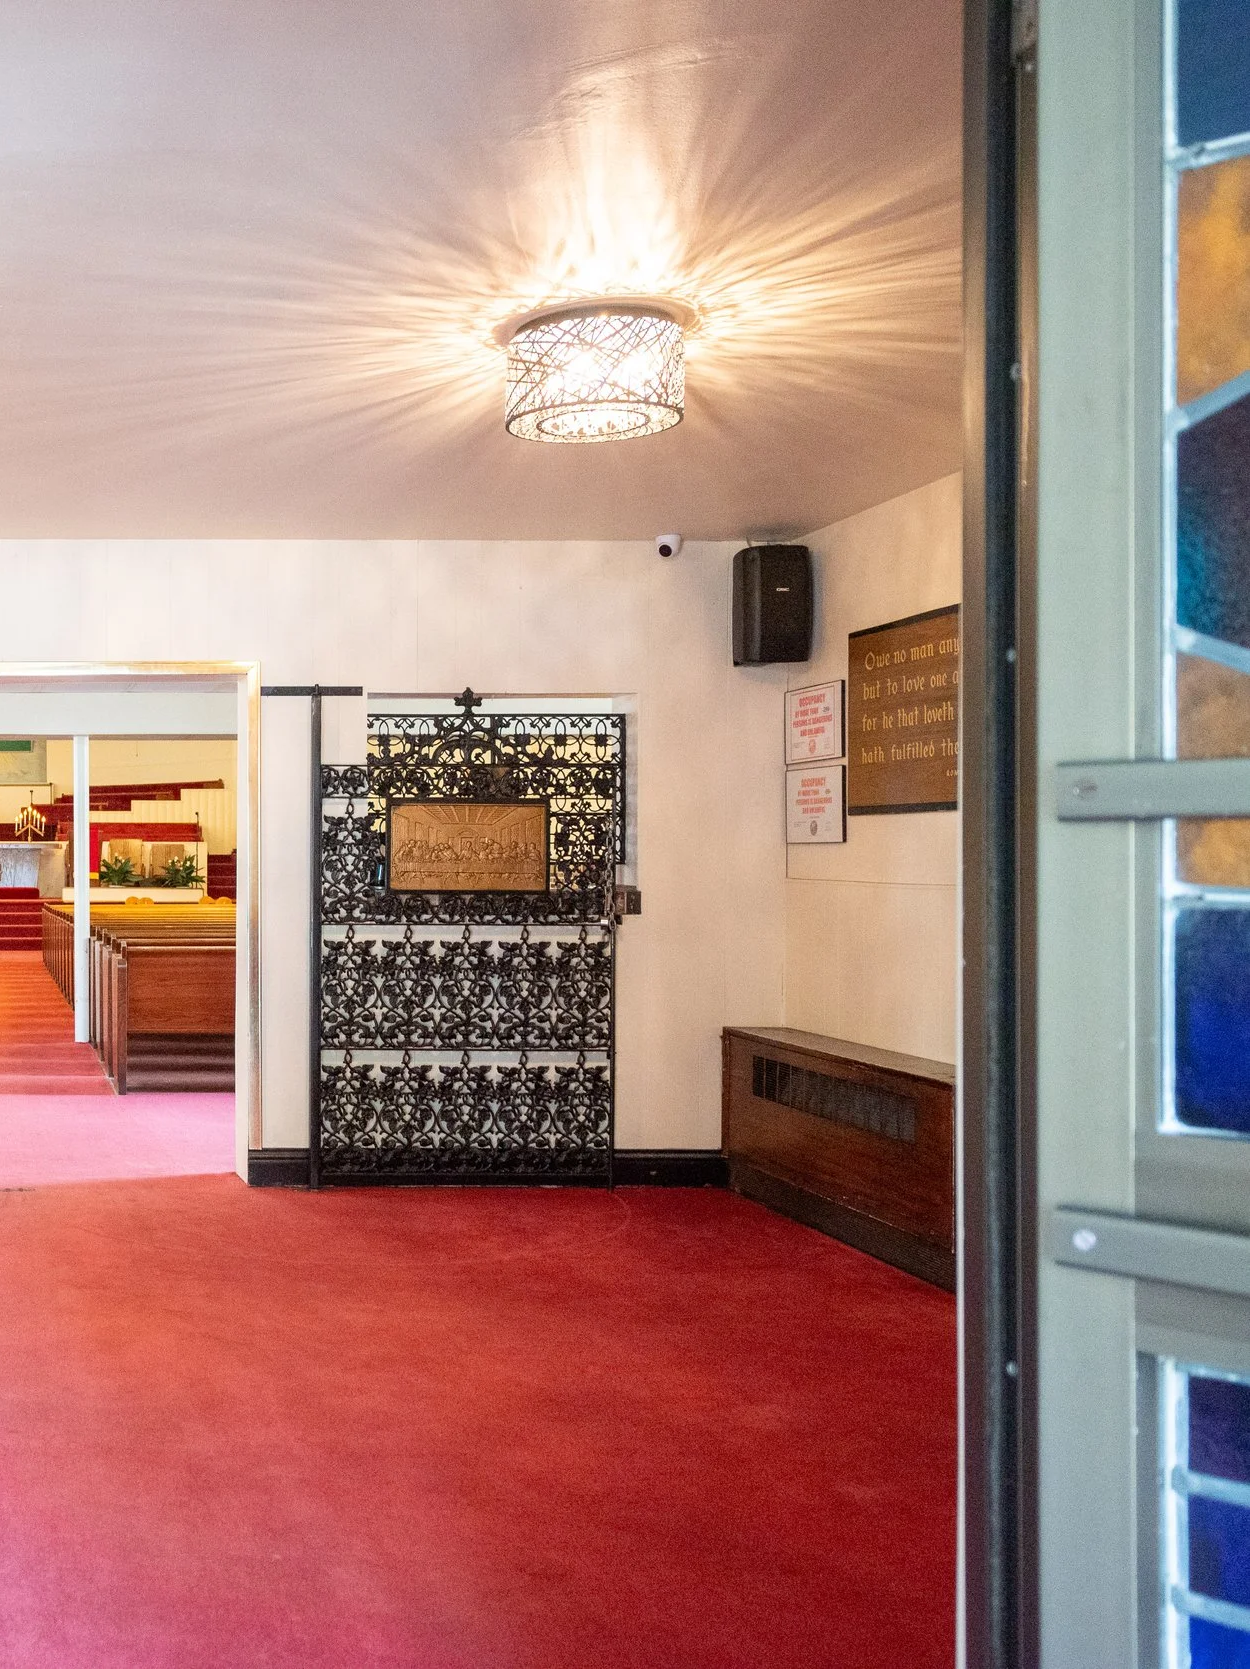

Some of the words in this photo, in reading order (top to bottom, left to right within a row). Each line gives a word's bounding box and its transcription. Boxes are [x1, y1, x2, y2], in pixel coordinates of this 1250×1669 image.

[864, 651, 890, 671] Owe
[893, 650, 906, 664] no
[910, 644, 934, 661] man
[798, 693, 826, 707] OCCUPANCY
[863, 681, 881, 701] but
[886, 679, 898, 696] to
[902, 676, 925, 693] love
[930, 673, 948, 688] one
[862, 714, 877, 732] for
[882, 711, 894, 730] he
[897, 707, 919, 728] that
[924, 701, 955, 725] loveth
[861, 746, 885, 765] hath
[891, 739, 935, 761] fulfilled
[800, 777, 826, 788] OCCUPANCY
